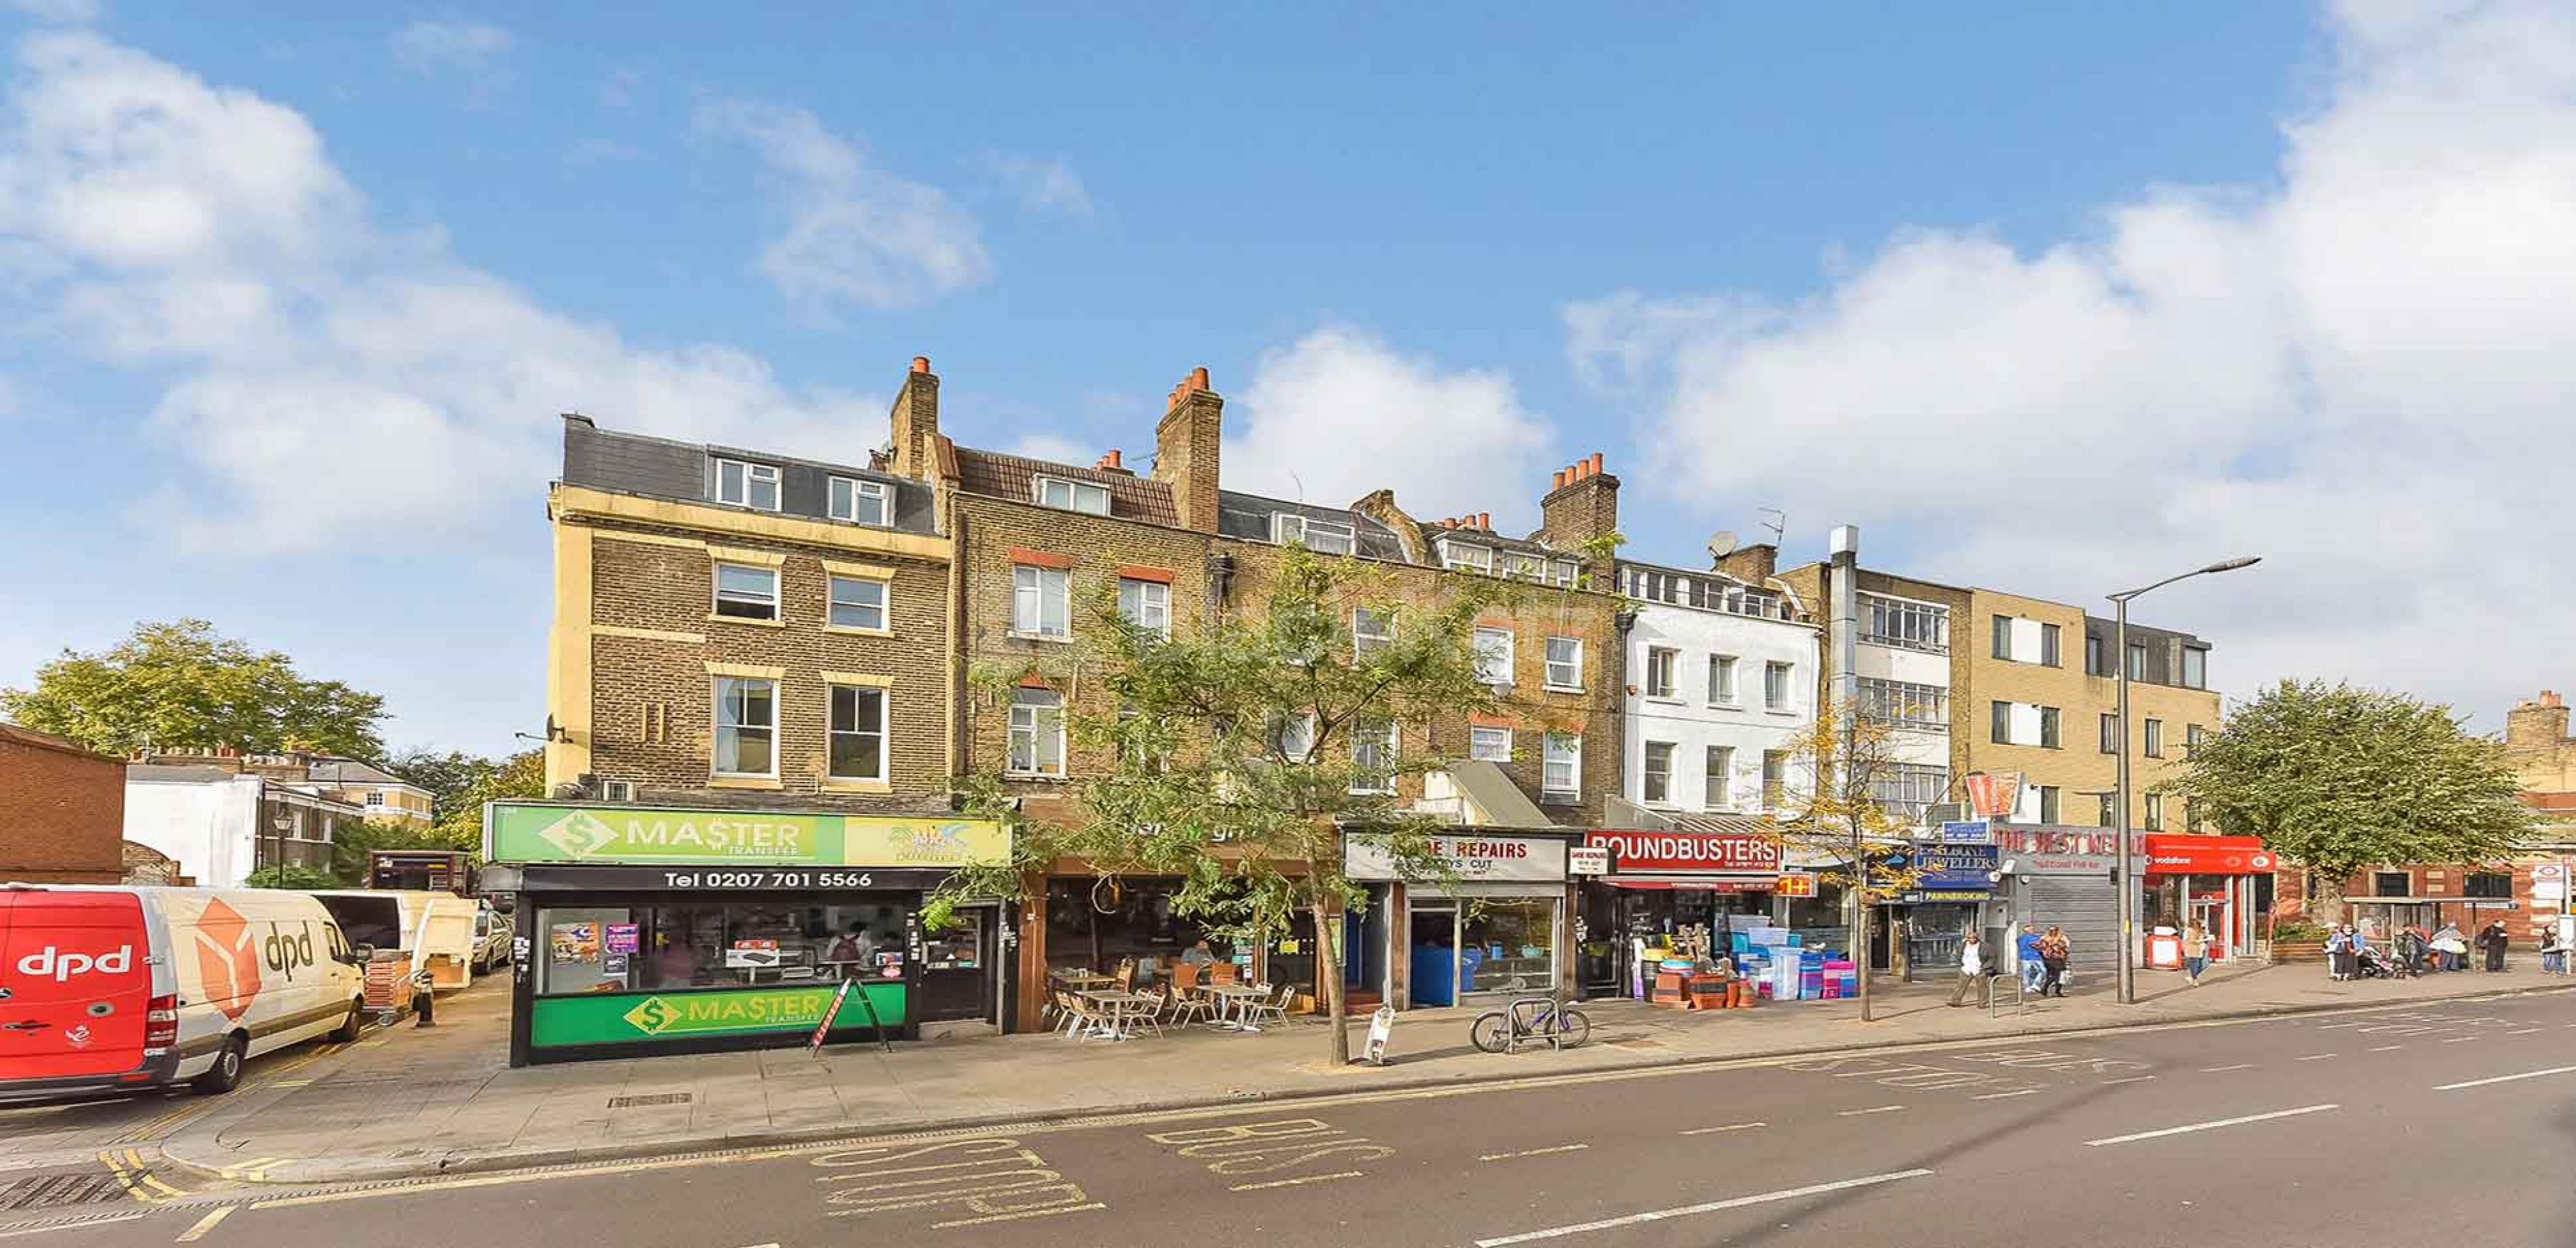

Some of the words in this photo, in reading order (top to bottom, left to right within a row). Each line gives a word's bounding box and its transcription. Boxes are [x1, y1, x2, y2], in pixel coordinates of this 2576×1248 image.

[1456, 841, 1528, 859] REPAIRS
[1469, 859, 1493, 868] CUT
[1921, 857, 1997, 870] JEWELLERS
[664, 873, 699, 887] Tel
[706, 873, 765, 887] 0207
[772, 873, 810, 887] 701
[818, 873, 872, 887] 5566
[18, 944, 133, 982] dpd
[265, 920, 313, 982] dpd
[1147, 1119, 1396, 1175] BUS
[809, 1139, 1086, 1216] STOP
